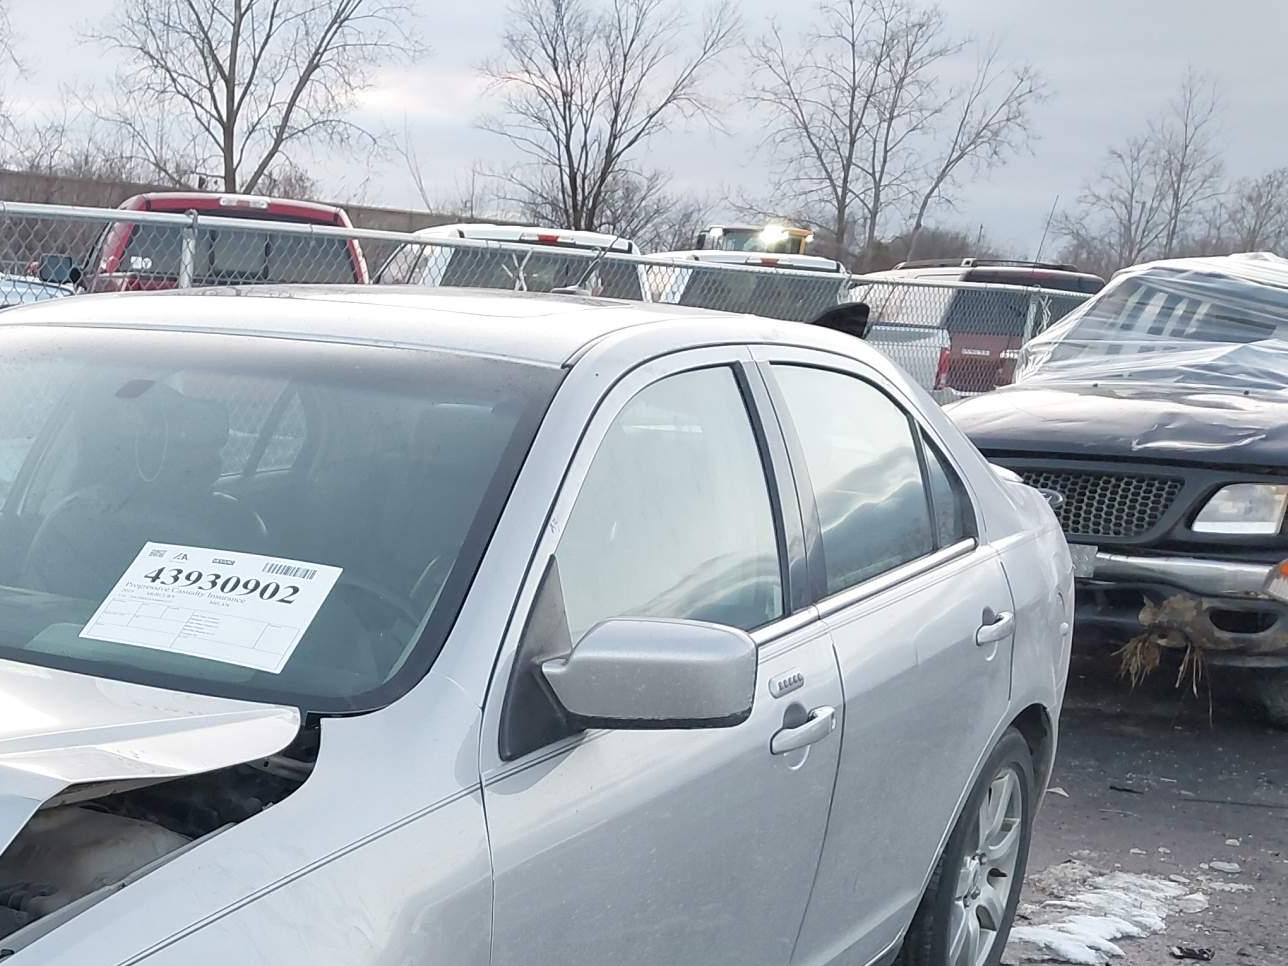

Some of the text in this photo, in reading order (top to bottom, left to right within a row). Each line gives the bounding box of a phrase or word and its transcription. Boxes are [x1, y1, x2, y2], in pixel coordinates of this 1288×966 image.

[125, 581, 171, 592] Progressive
[171, 587, 205, 598] Casualty
[207, 592, 247, 604] Insurance
[144, 566, 300, 604] 43930902
